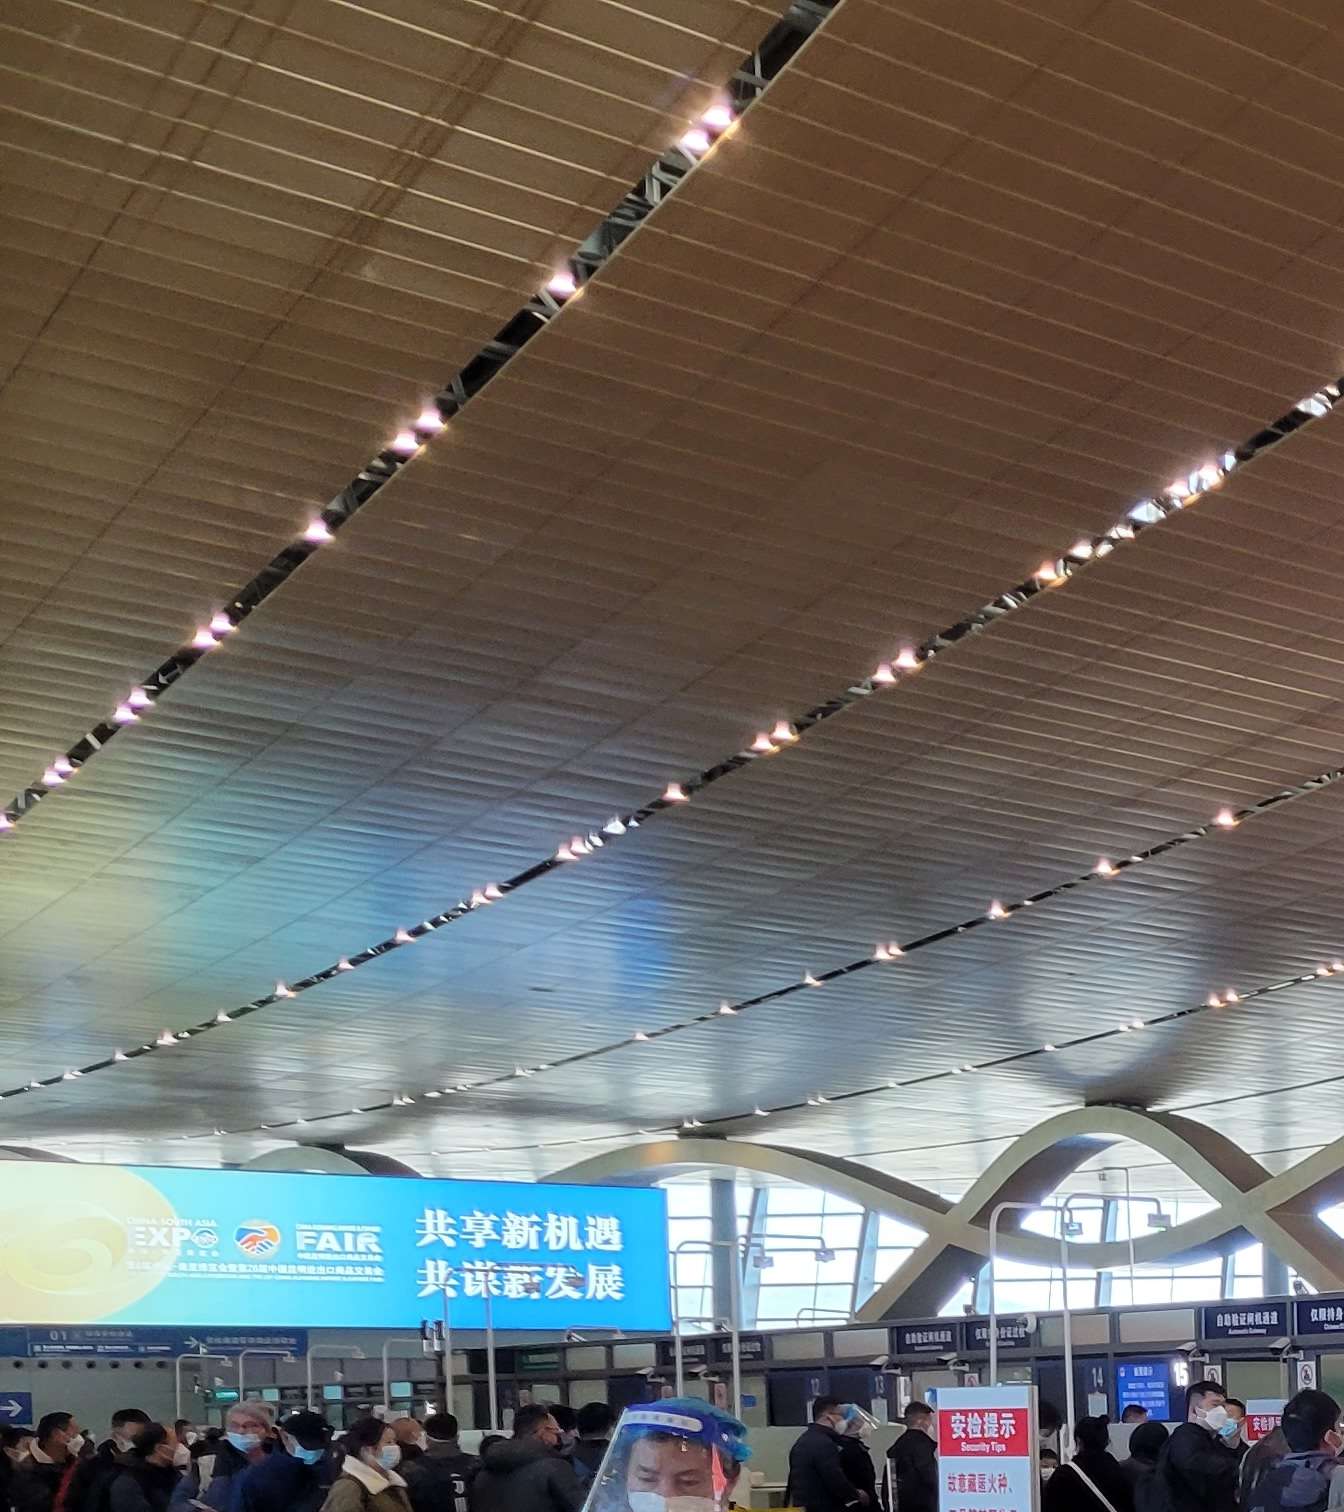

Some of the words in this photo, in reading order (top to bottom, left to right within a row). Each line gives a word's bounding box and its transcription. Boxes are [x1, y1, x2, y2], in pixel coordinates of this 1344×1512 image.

[296, 1231, 383, 1254] FAIR
[416, 1208, 624, 1251] 共享新机遇
[416, 1259, 624, 1300] 共谋新发展
[1173, 1361, 1189, 1387] 15
[951, 1412, 1016, 1439] 安检提示
